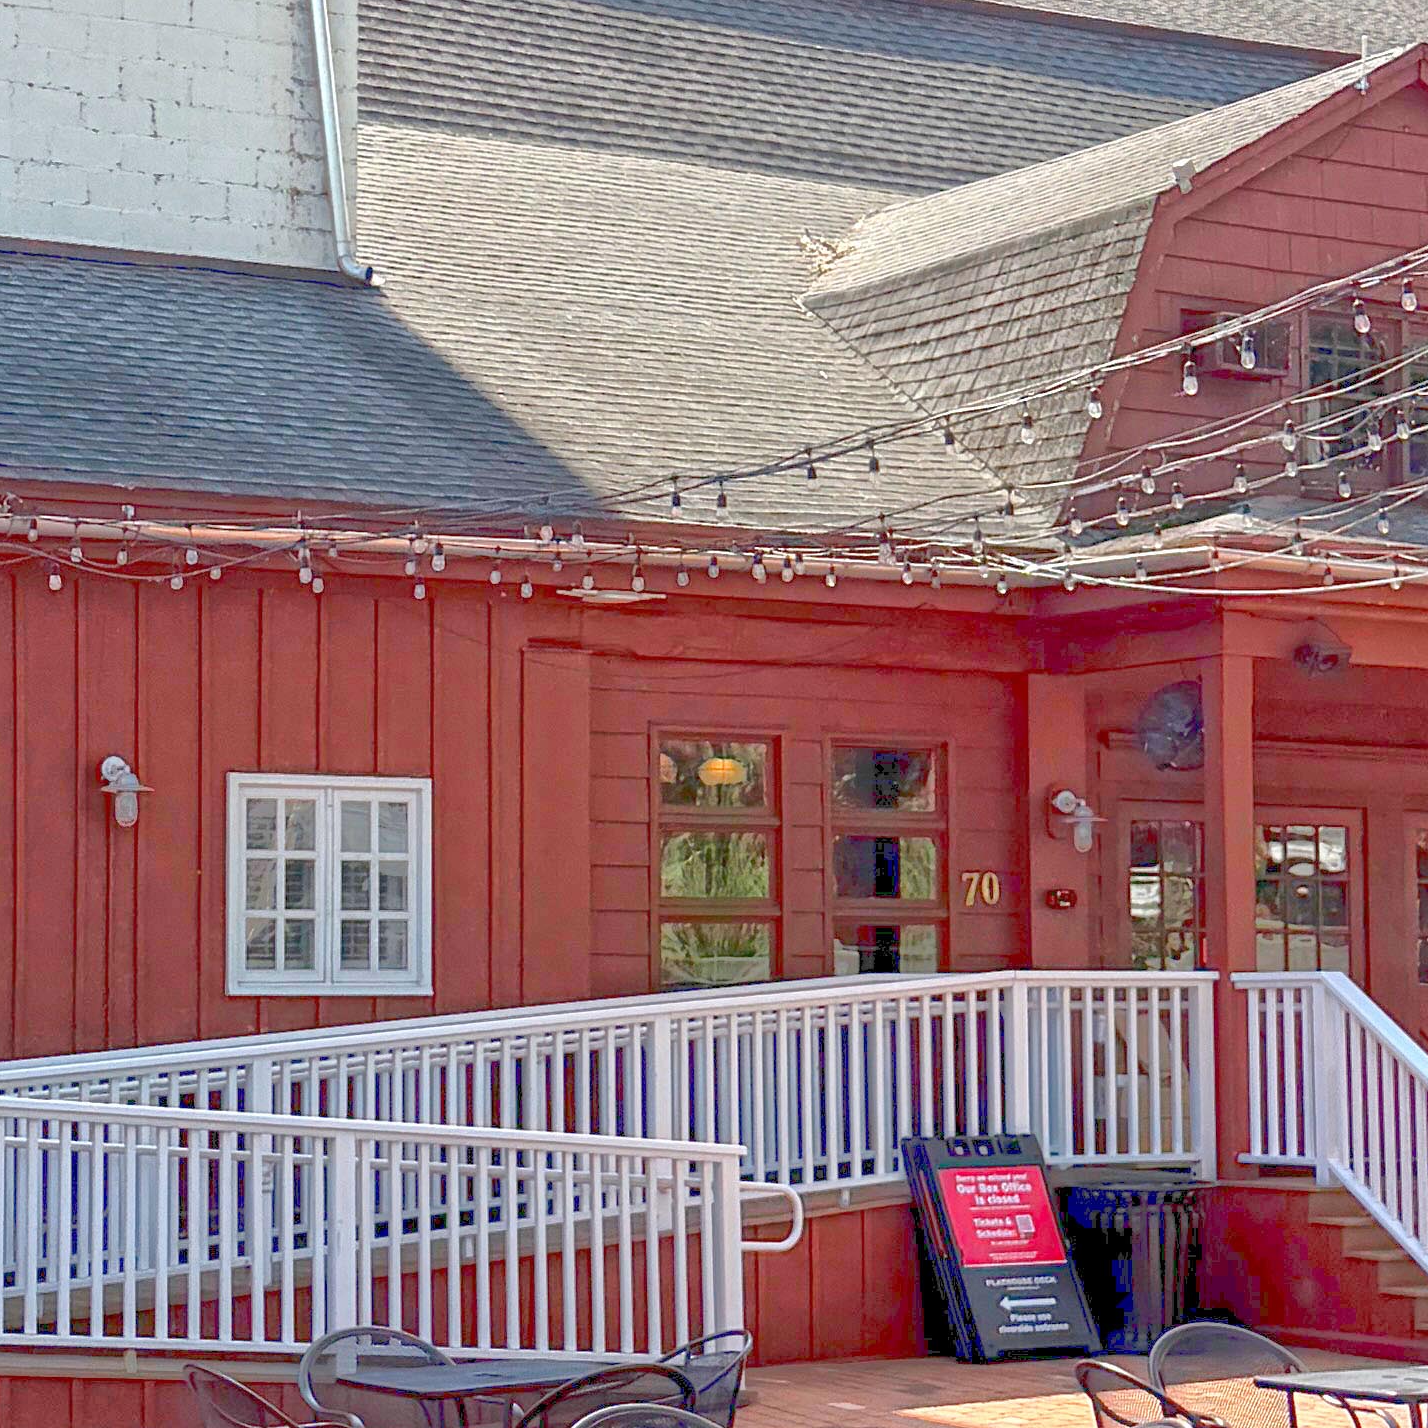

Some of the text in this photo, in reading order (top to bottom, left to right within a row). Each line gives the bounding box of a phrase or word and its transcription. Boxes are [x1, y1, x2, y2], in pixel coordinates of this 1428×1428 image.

[962, 872, 1000, 907] 70
[956, 1182, 1032, 1194] Our Box Office
[987, 1194, 1021, 1204] closed
[973, 1217, 1003, 1227] Tickets
